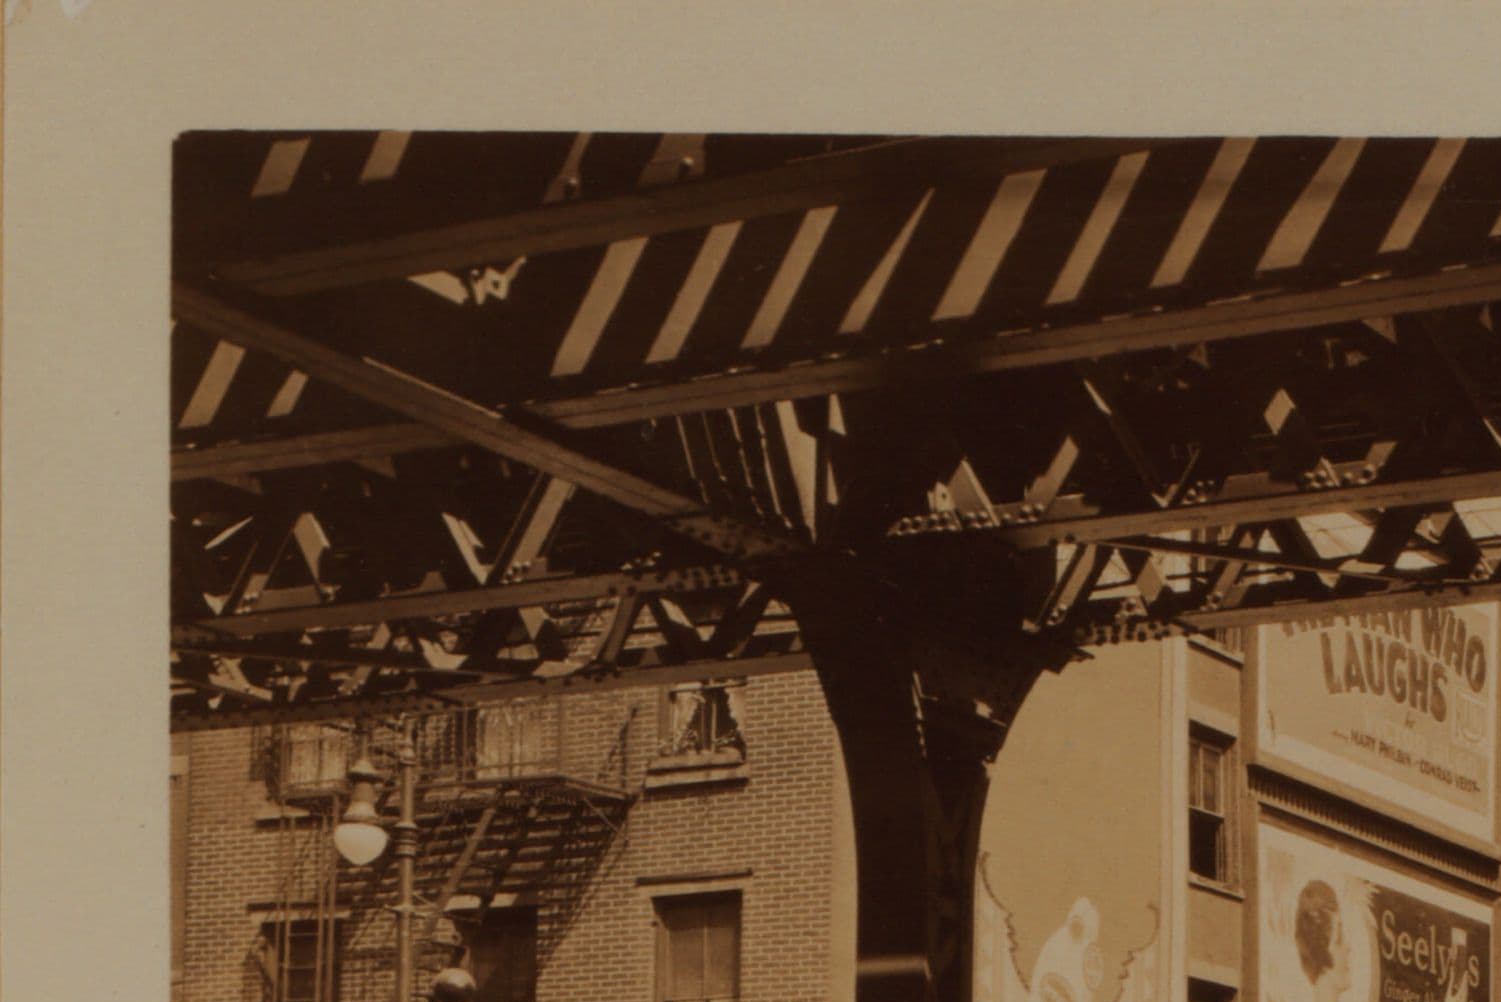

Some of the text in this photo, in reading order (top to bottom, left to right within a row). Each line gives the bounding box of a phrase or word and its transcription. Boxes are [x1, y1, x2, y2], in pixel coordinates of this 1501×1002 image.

[1320, 631, 1448, 723] LAUGHS
[1421, 607, 1487, 693] WHO
[1380, 908, 1480, 989] Seelys
